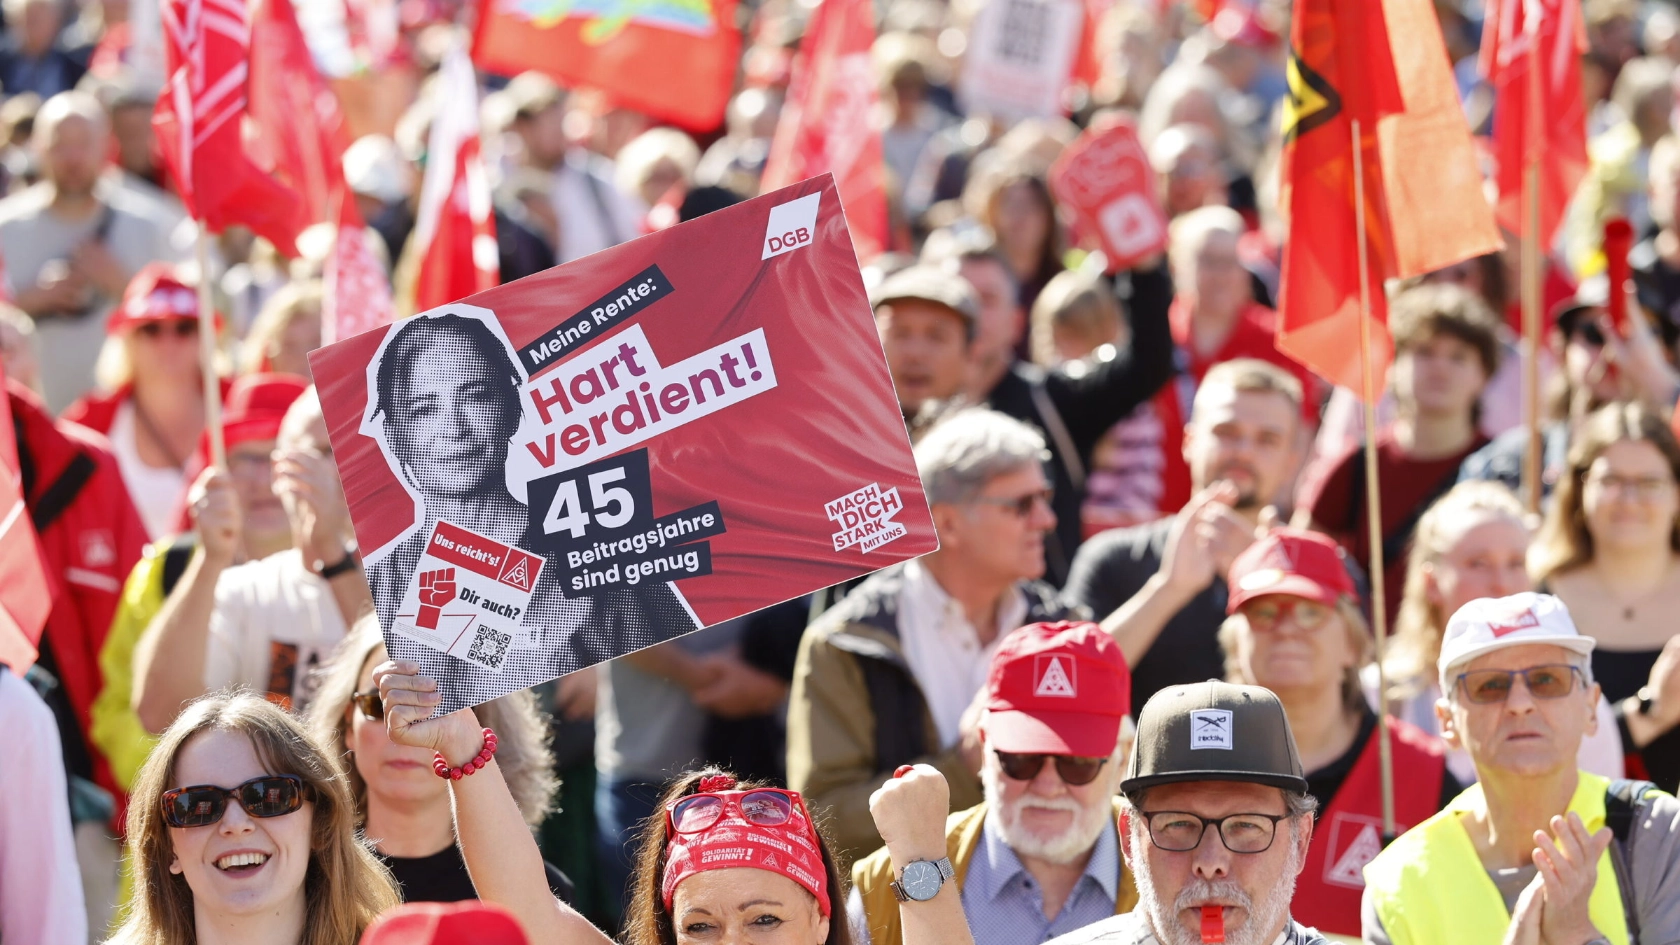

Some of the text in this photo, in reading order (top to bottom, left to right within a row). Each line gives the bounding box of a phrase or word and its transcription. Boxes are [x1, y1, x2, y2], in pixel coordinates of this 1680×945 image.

[767, 227, 810, 253] DGB
[528, 278, 658, 365] Meine Rente:
[529, 341, 646, 424] Hart
[525, 342, 764, 469] verdient!
[542, 466, 635, 539] 45
[828, 487, 877, 516] MACH
[843, 492, 899, 530] DICH
[434, 533, 501, 567] Uns reicht's!
[567, 510, 715, 569] Beitragsjahre
[834, 519, 886, 549] STARK
[863, 529, 903, 552] MIT UNS
[571, 549, 700, 591] sind genug
[459, 587, 521, 620] Dir auch?
[702, 847, 746, 857] SOLIDARITÄT
